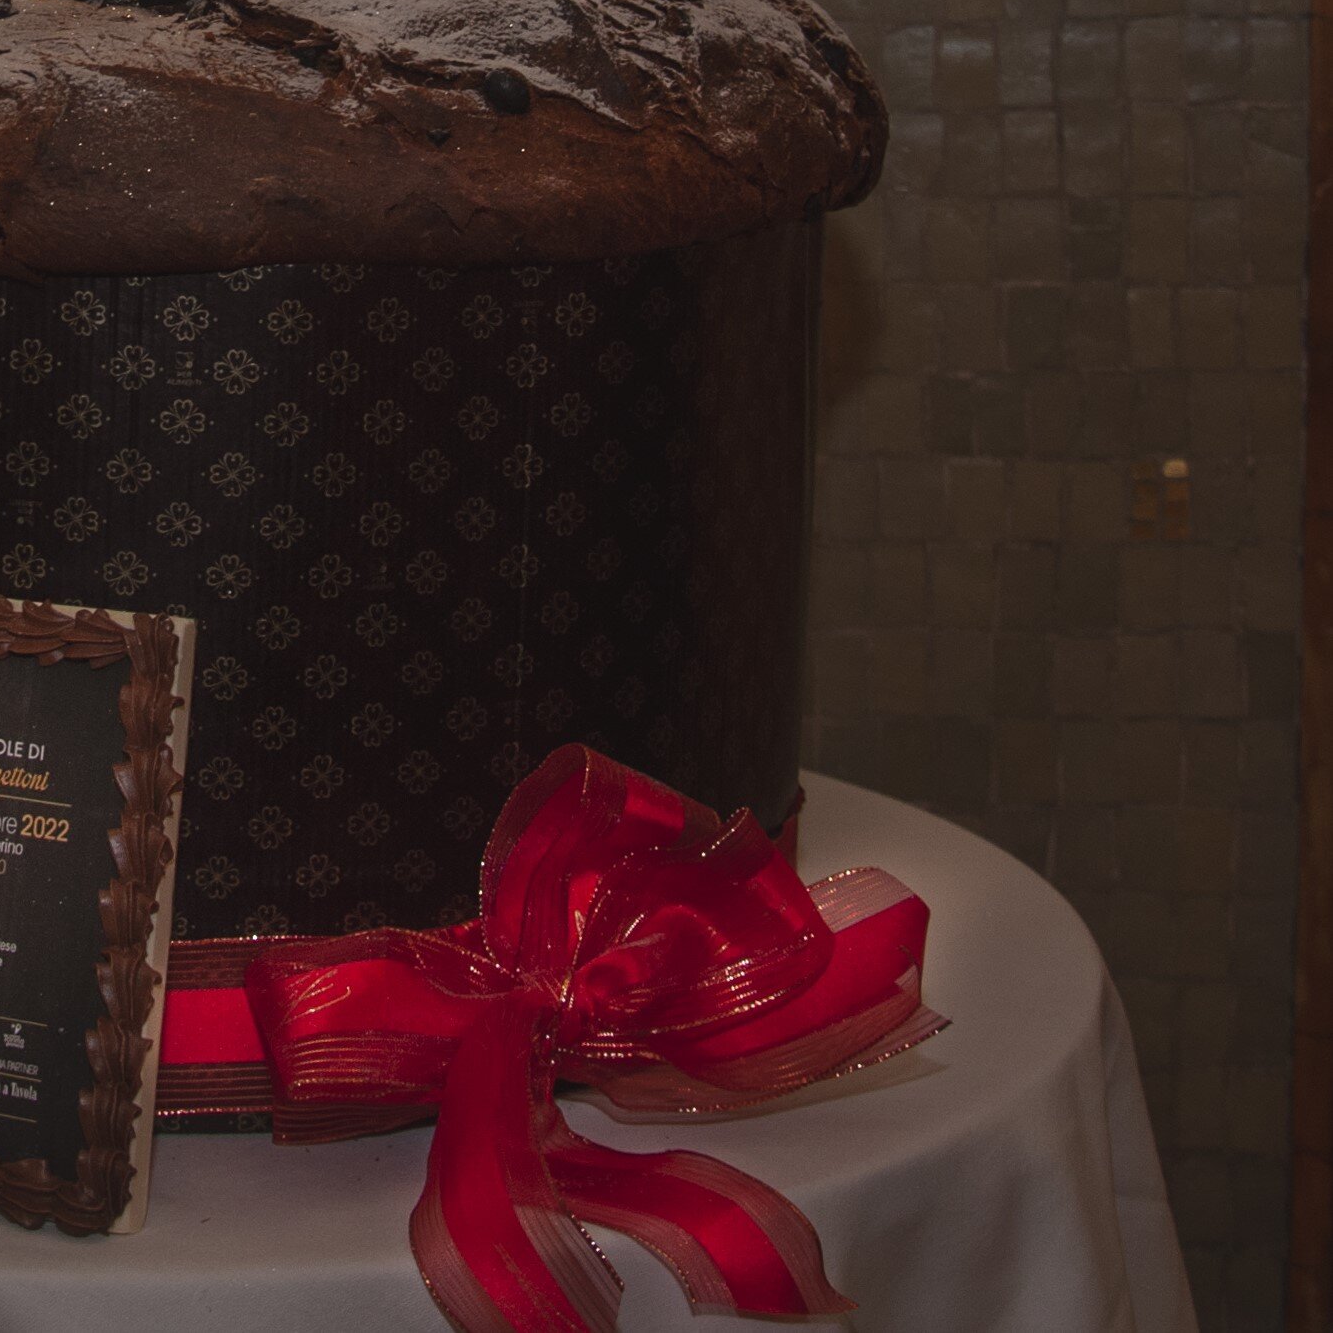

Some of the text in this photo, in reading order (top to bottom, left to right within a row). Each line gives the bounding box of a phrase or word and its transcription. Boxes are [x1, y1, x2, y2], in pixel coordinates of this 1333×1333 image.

[28, 742, 45, 761] DI
[20, 813, 70, 843] 2022
[7, 1060, 39, 1075] PARTNER
[2, 1084, 9, 1095] a
[11, 1082, 38, 1101] Tavola
